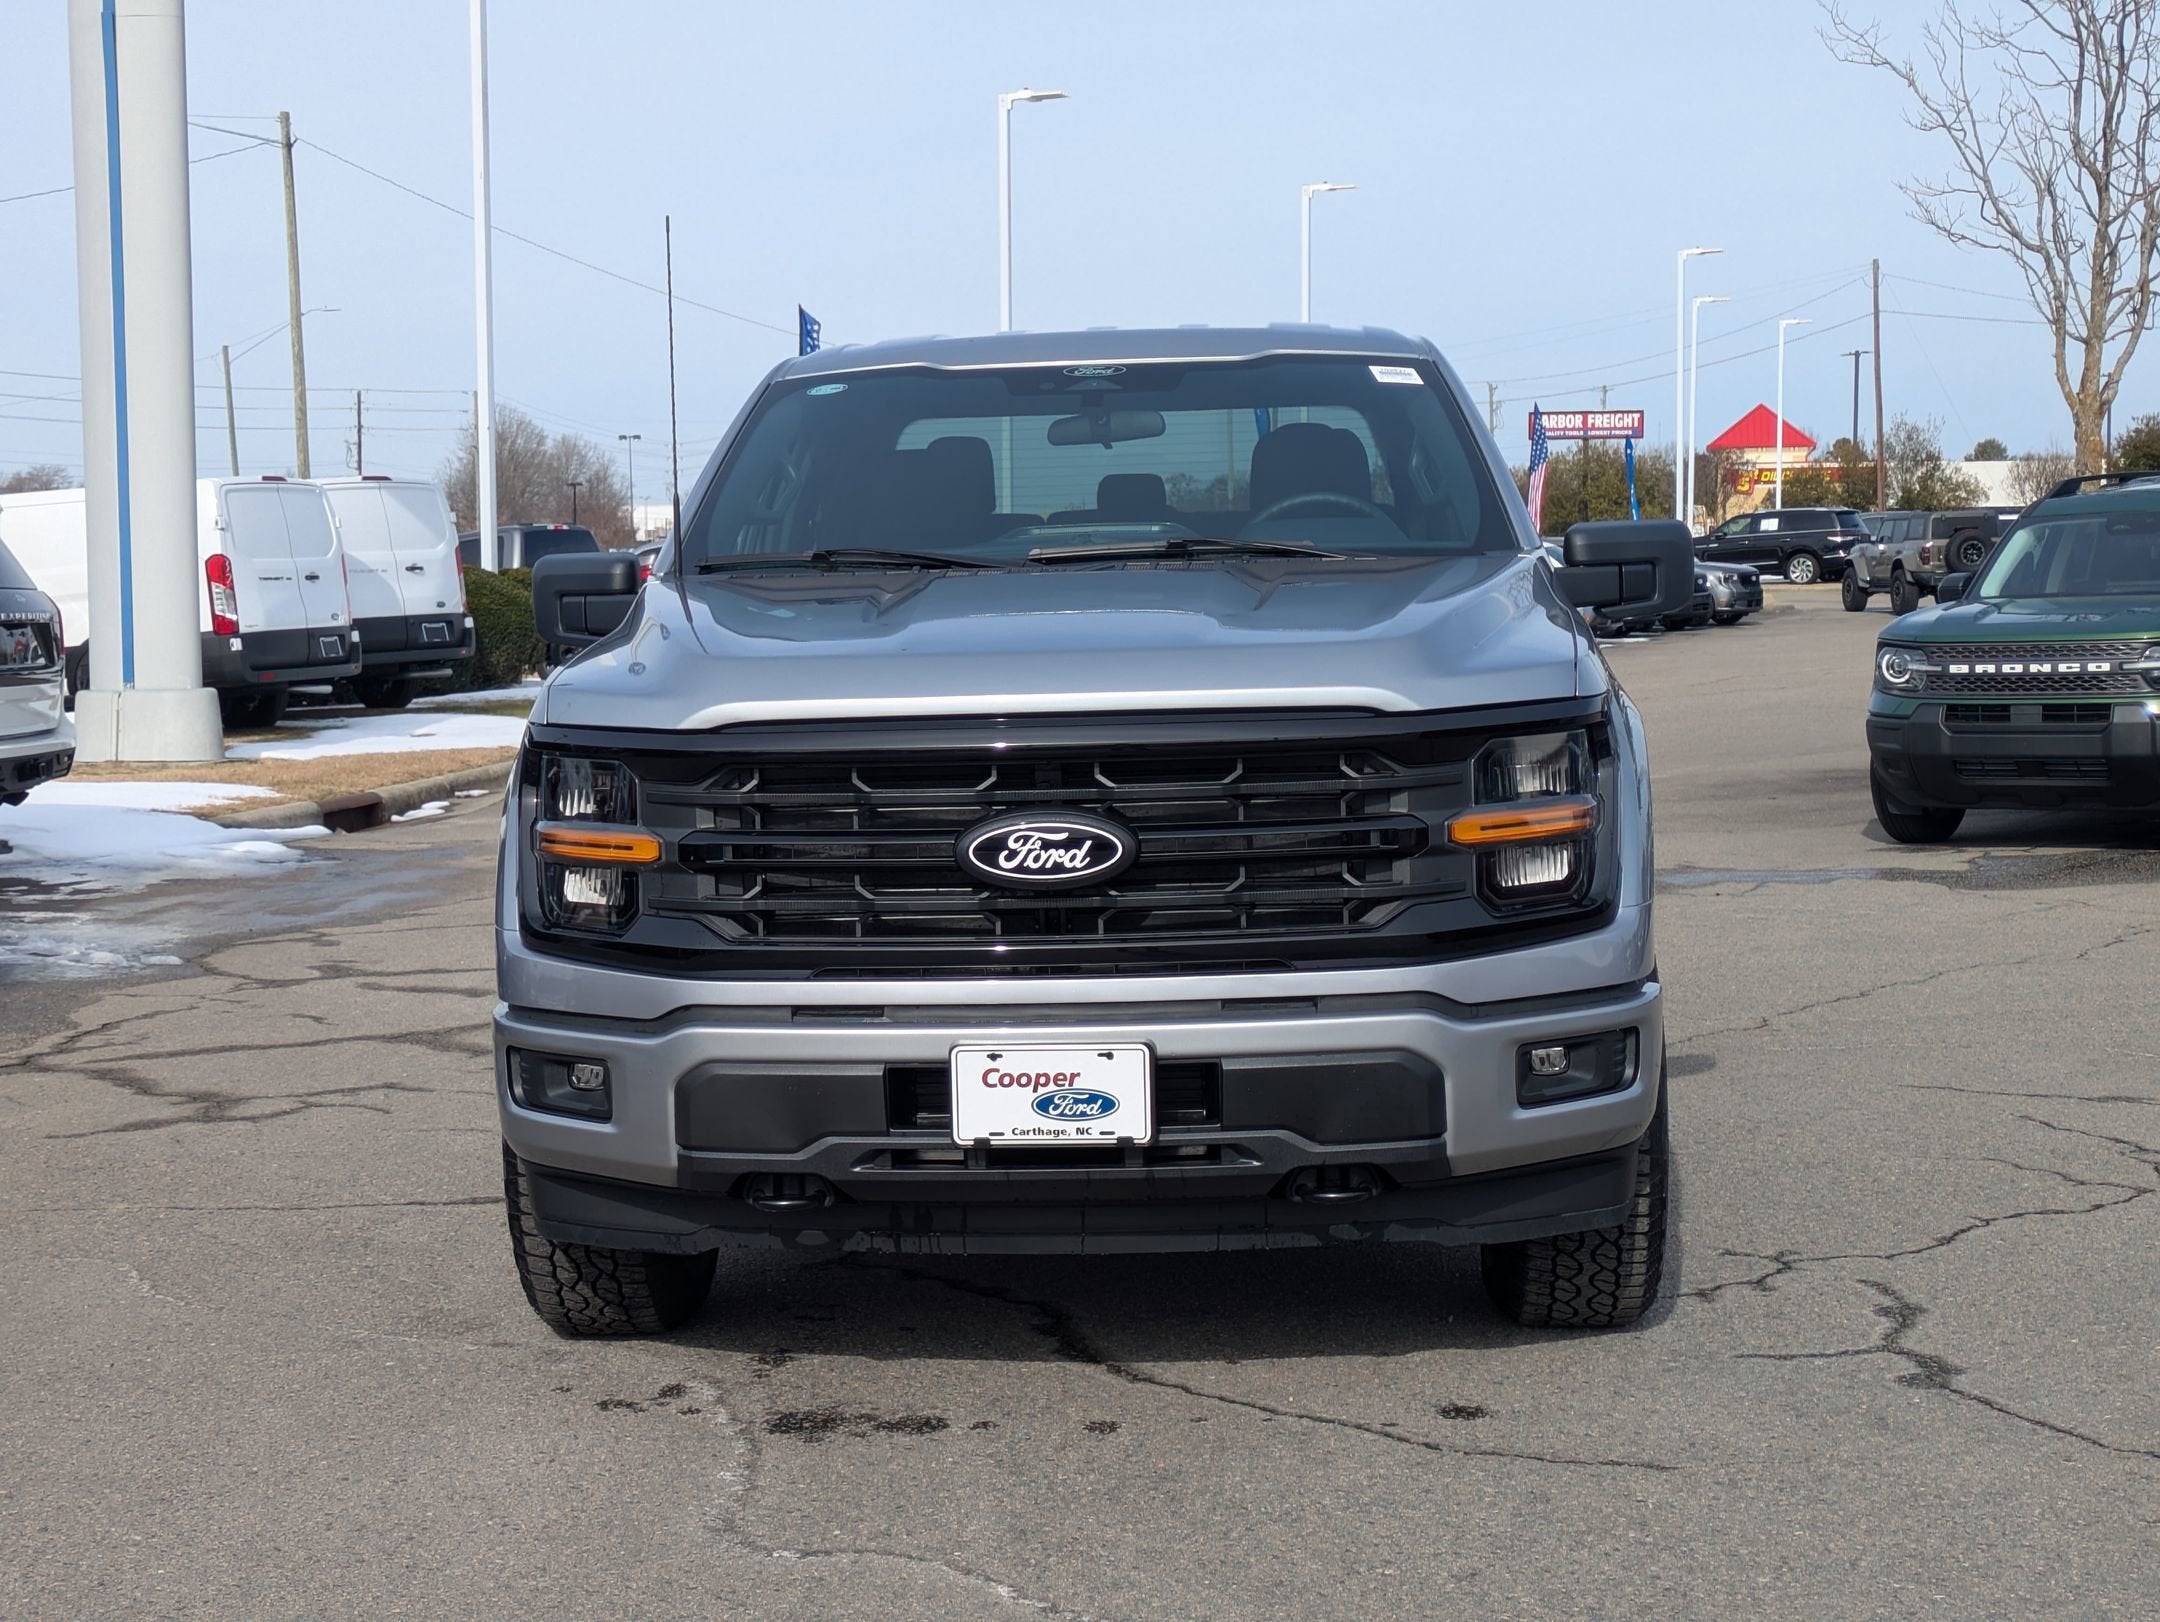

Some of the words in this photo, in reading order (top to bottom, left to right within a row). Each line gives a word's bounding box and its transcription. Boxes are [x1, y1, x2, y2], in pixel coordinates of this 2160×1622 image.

[1074, 366, 1115, 375] Ford
[1530, 413, 1583, 429] ARBOR
[1587, 412, 1640, 428] FREIGHT
[1949, 663, 2111, 673] BRONCO
[998, 831, 1093, 869] Ford
[982, 1068, 1081, 1093] Cooper
[1049, 1093, 1103, 1115] Ford
[1011, 1127, 1071, 1138] Carthage,
[1076, 1127, 1093, 1136] NC
